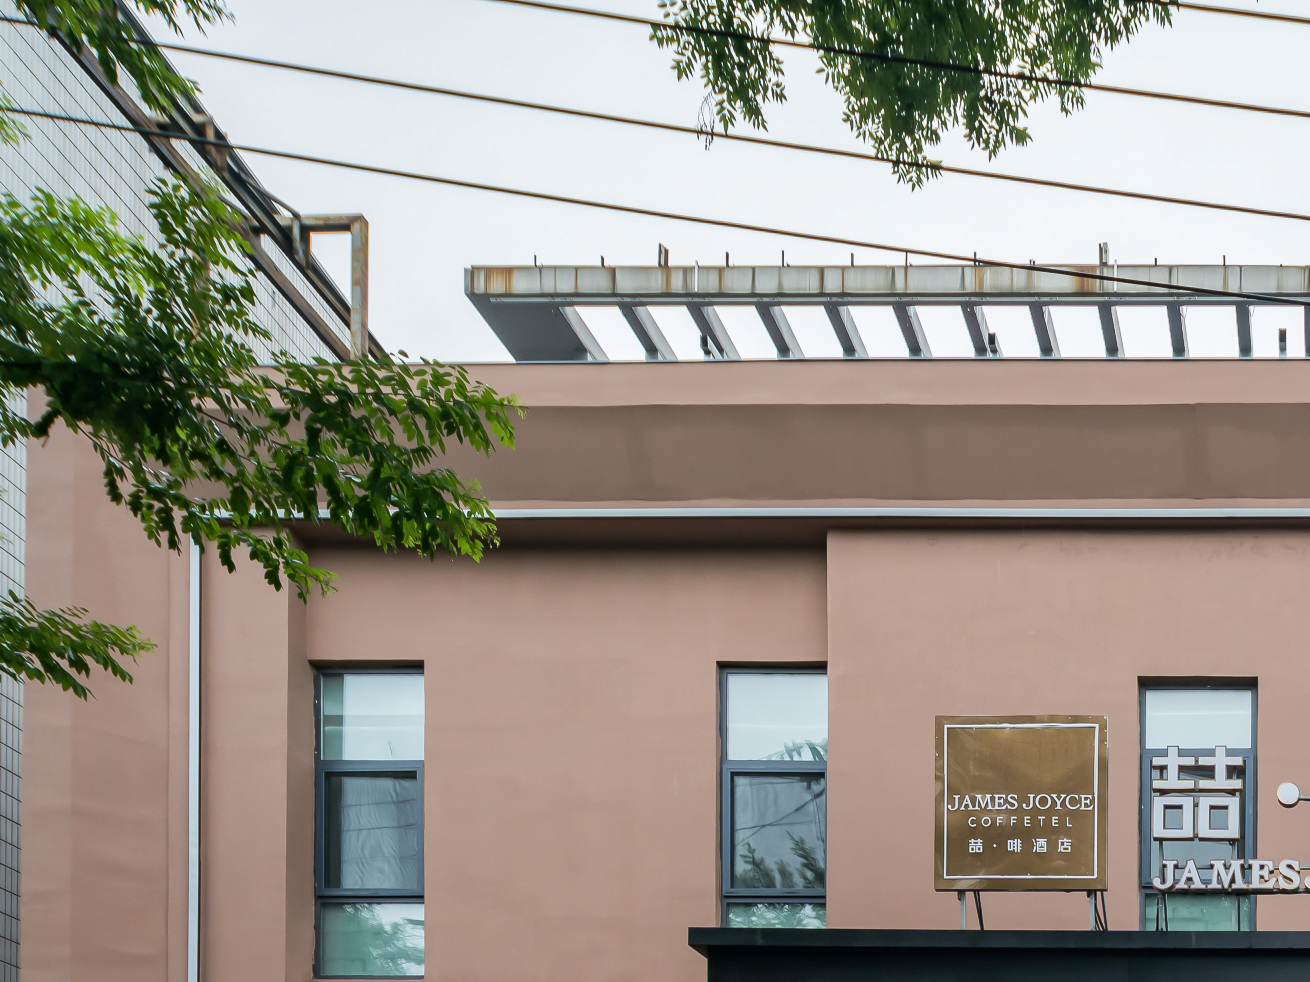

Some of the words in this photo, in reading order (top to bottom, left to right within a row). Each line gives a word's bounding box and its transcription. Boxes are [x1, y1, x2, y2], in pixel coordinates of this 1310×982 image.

[948, 794, 1018, 811] JAMES
[1022, 794, 1094, 811] JOYCE
[967, 816, 1073, 827] COFFETEL
[1152, 858, 1301, 892] JAMES
